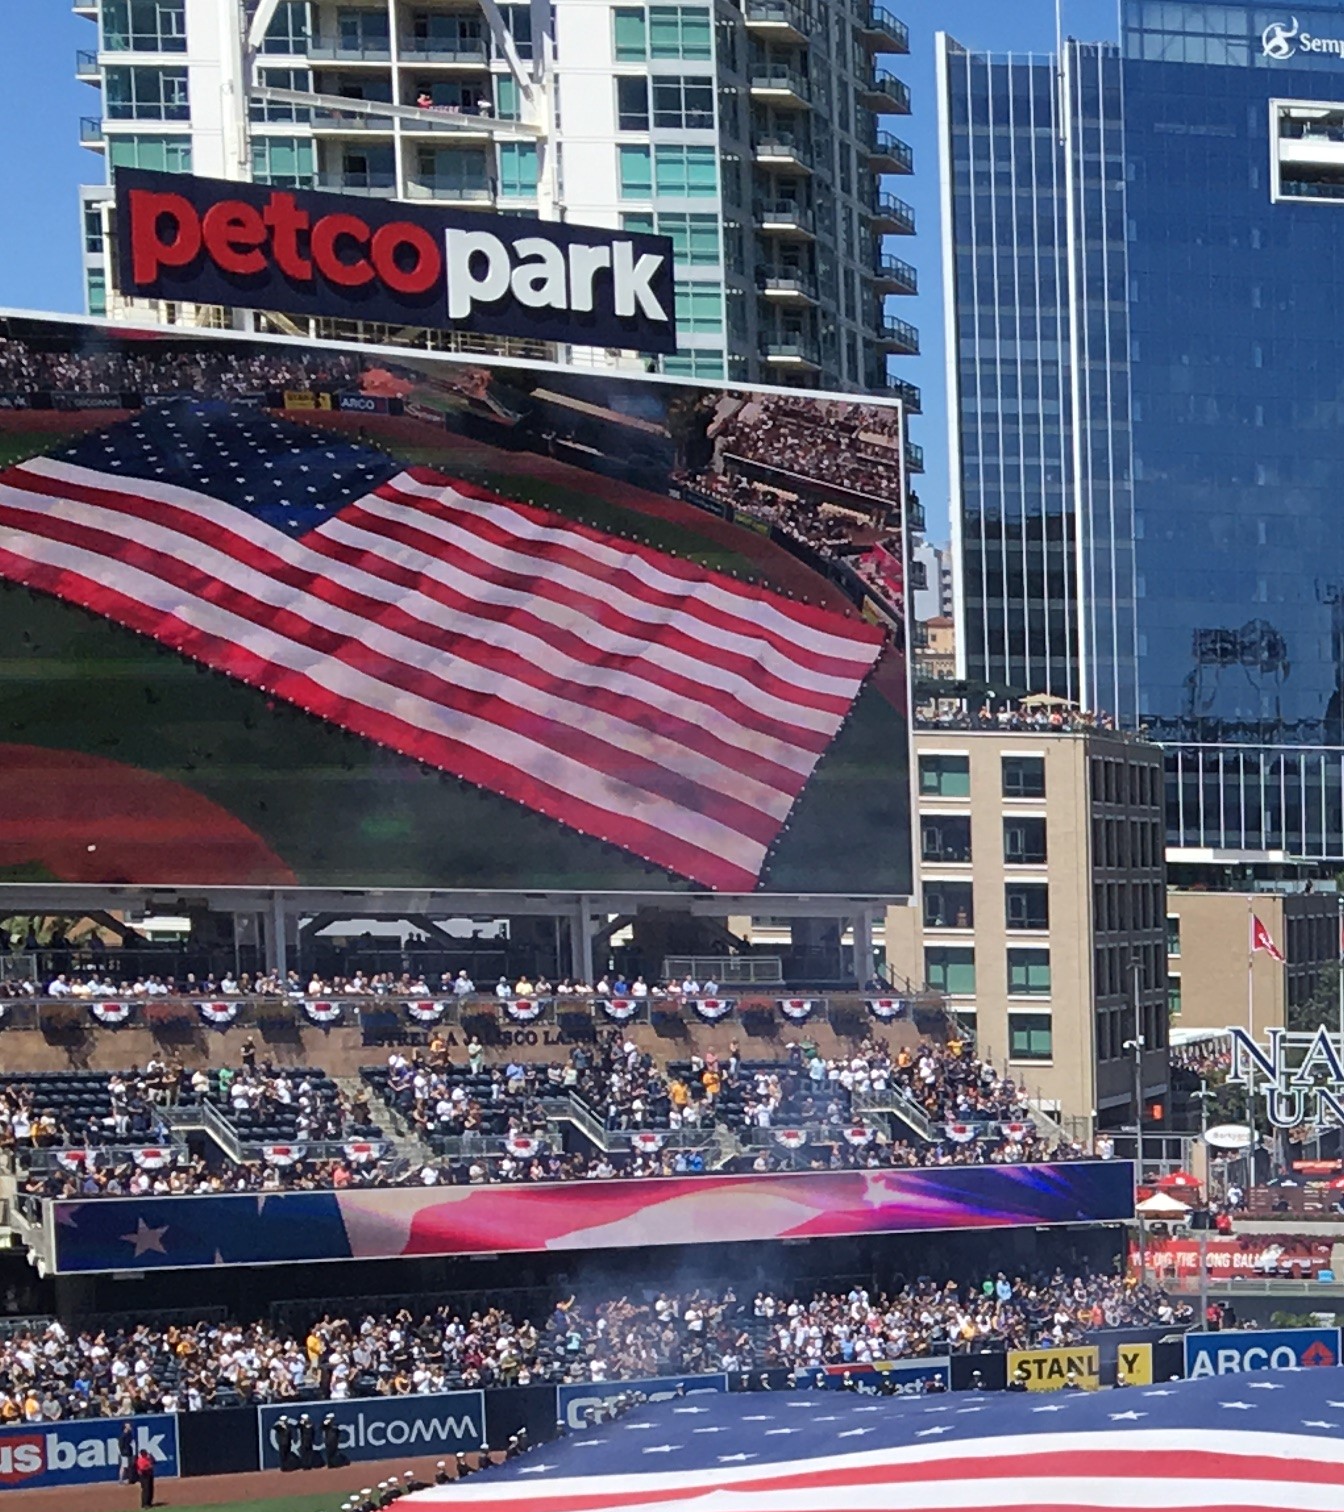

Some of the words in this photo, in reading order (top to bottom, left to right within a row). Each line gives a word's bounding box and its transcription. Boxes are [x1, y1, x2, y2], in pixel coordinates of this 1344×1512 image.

[1153, 1251, 1175, 1267] DIG
[1175, 1251, 1197, 1267] THE
[1198, 1251, 1230, 1267] ONG
[1191, 1346, 1298, 1378] ARCO
